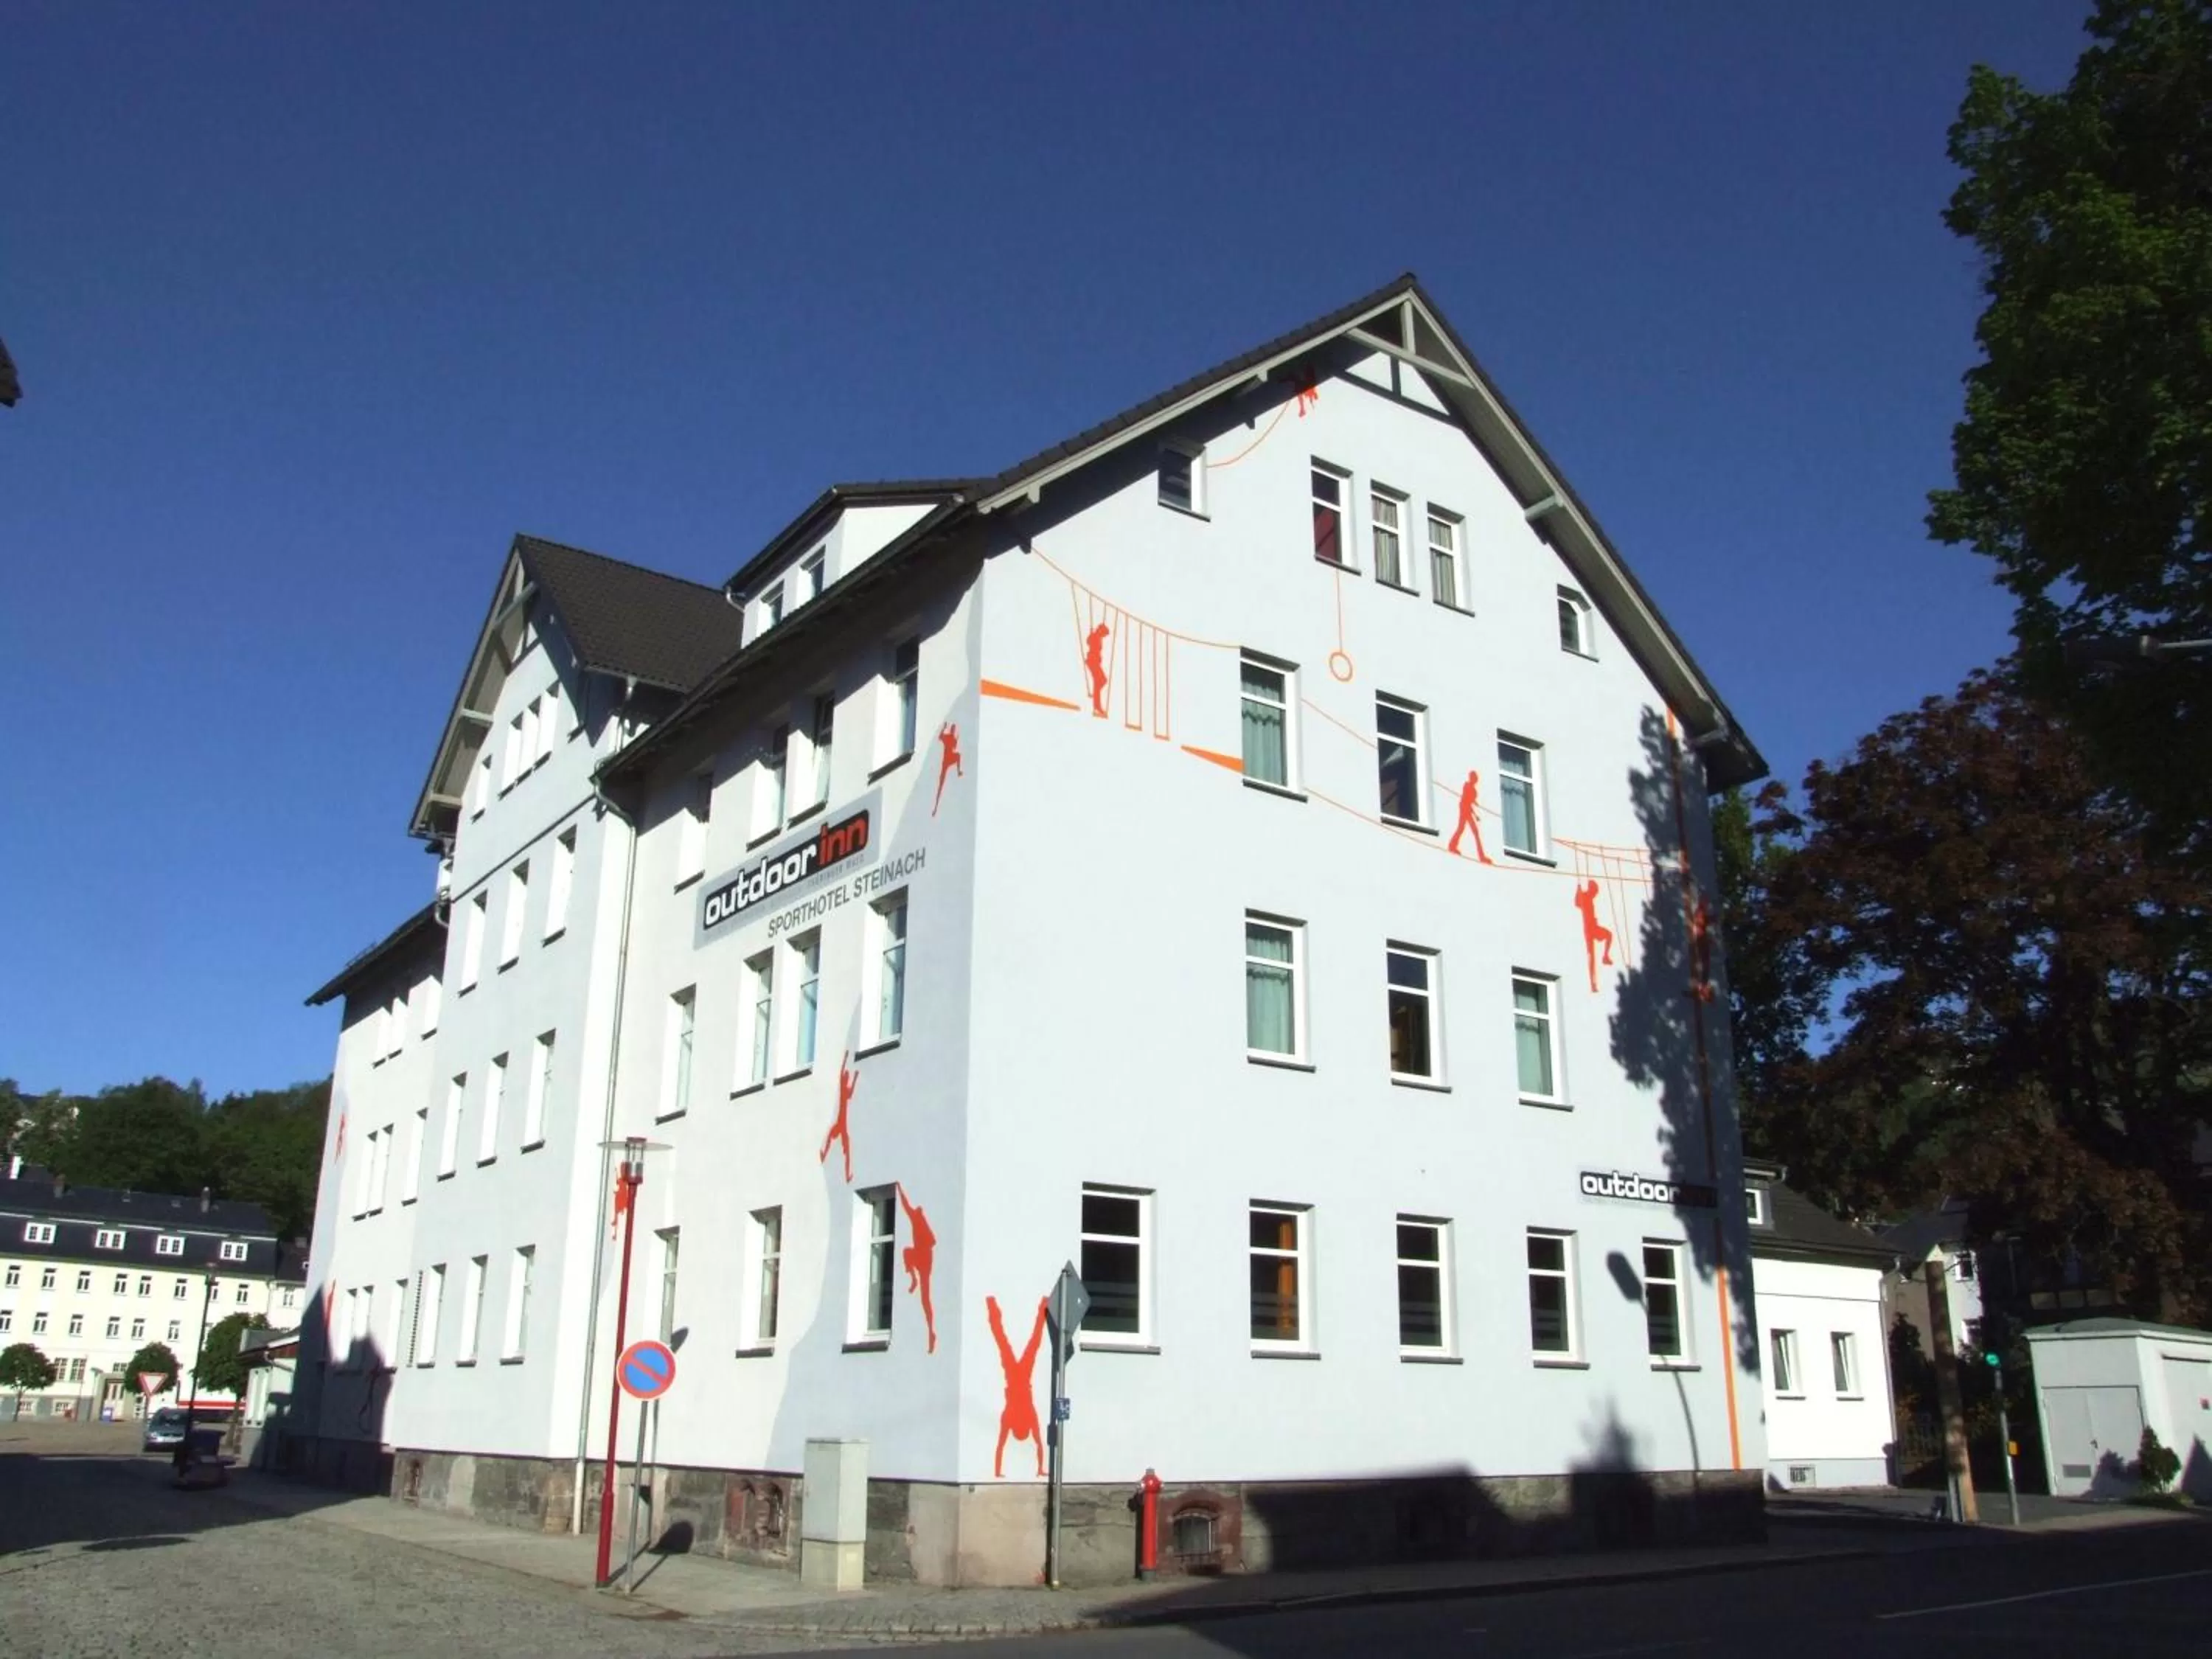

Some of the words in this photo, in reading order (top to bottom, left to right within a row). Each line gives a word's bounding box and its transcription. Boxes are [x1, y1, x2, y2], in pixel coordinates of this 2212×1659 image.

[768, 884, 850, 938] SPORTHOTEL
[853, 847, 926, 897] STEINACH
[1583, 1172, 1680, 1202] outdoor
